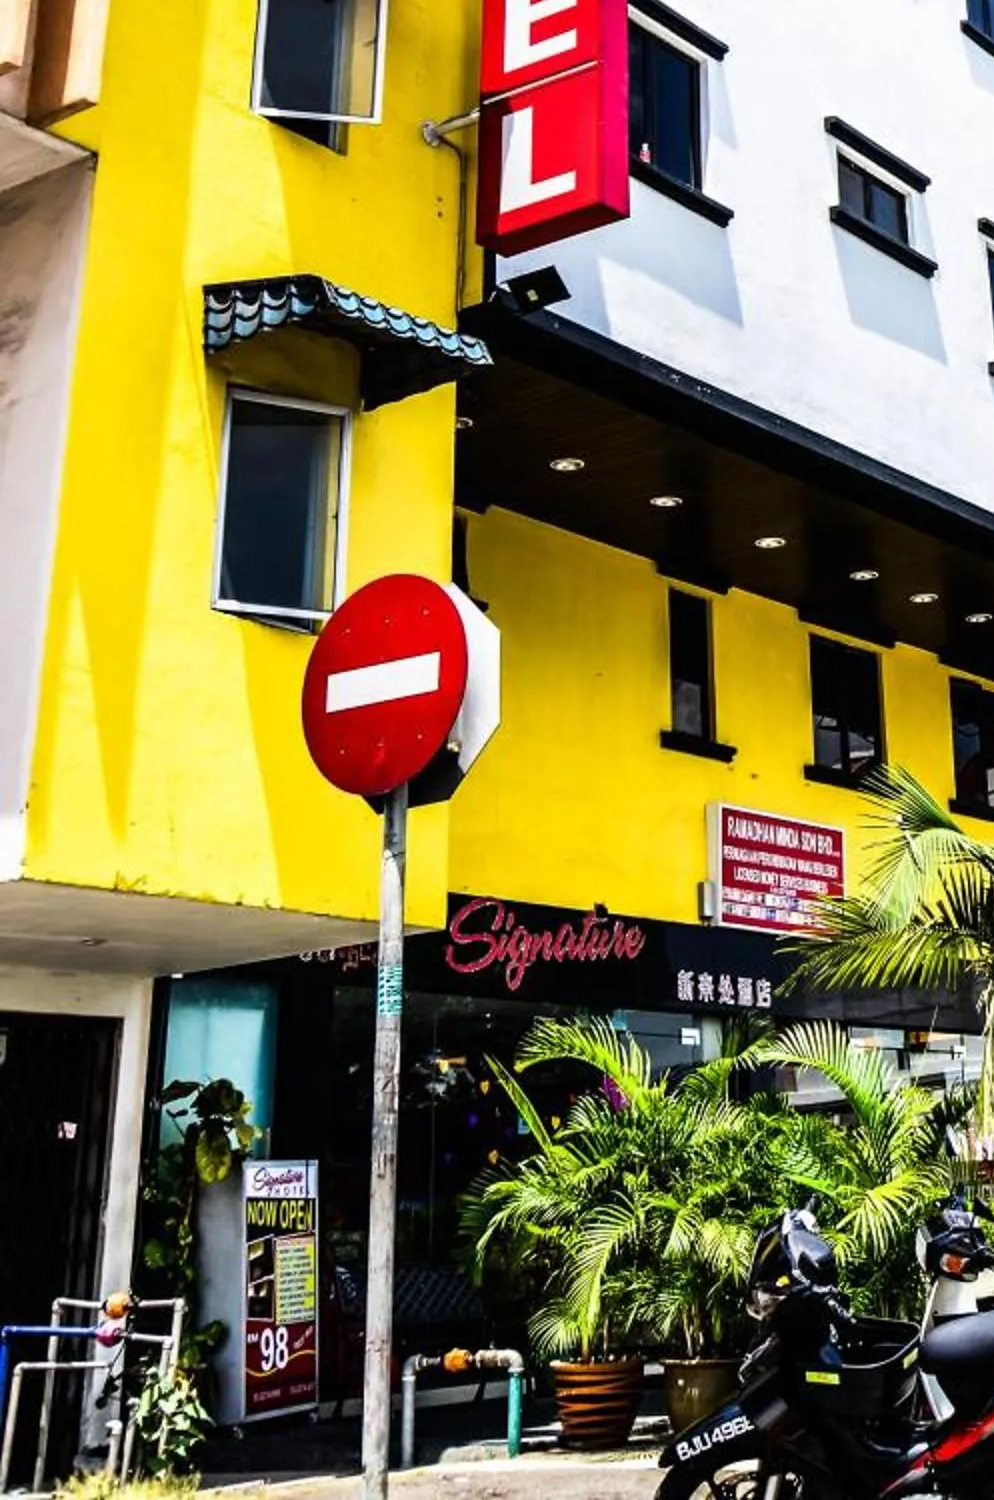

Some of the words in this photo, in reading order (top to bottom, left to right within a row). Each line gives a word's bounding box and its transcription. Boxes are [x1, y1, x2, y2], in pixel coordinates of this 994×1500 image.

[446, 897, 646, 991] Signature
[247, 1199, 277, 1228] NOW
[279, 1199, 313, 1232] OPEN
[260, 1326, 289, 1372] 98
[676, 1432, 712, 1461] BJU
